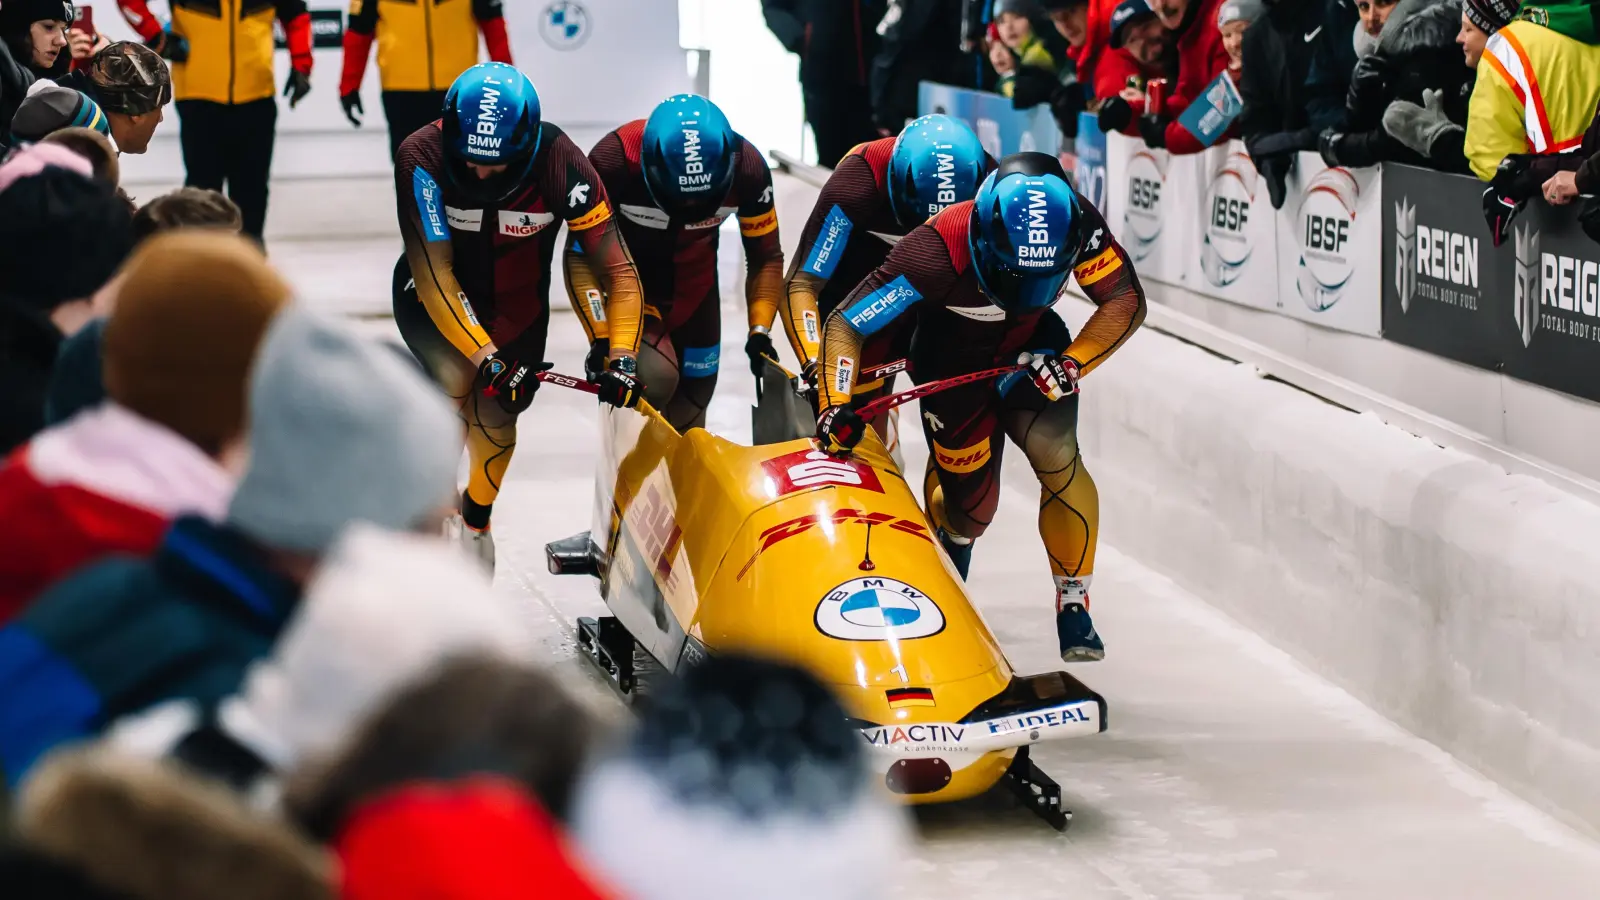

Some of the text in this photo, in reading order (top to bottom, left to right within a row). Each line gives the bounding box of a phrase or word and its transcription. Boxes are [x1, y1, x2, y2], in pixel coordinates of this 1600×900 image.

[477, 87, 501, 136] BMW
[467, 134, 502, 148] BMW
[467, 147, 500, 157] helmets
[682, 129, 704, 174] BMW
[678, 173, 712, 186] BMW
[680, 184, 711, 193] helmets
[936, 153, 956, 203] BMW
[1129, 176, 1161, 210] IBSF
[1027, 189, 1049, 244] BMW
[1212, 195, 1250, 232] IBSF
[1305, 214, 1350, 253] IBSF
[1018, 246, 1057, 258] BMW
[1018, 259, 1055, 268] helmets
[1417, 225, 1479, 288] REIGN
[1417, 282, 1478, 311] TOTAL BODY FUEL
[1541, 313, 1566, 333] TOTAL
[1569, 320, 1590, 339] BODY
[509, 366, 527, 388] SEIZ
[544, 373, 577, 387] FES
[613, 372, 636, 388] SEIZ
[875, 361, 906, 378] FES
[1050, 359, 1068, 385] SEIZ
[822, 406, 841, 434] SEIZ
[937, 450, 982, 467] DHL
[758, 508, 936, 555] DHL
[828, 579, 923, 602] BMW
[890, 663, 910, 683] 1
[1017, 707, 1090, 731] IDEAL
[861, 725, 965, 745] VIACTIV
